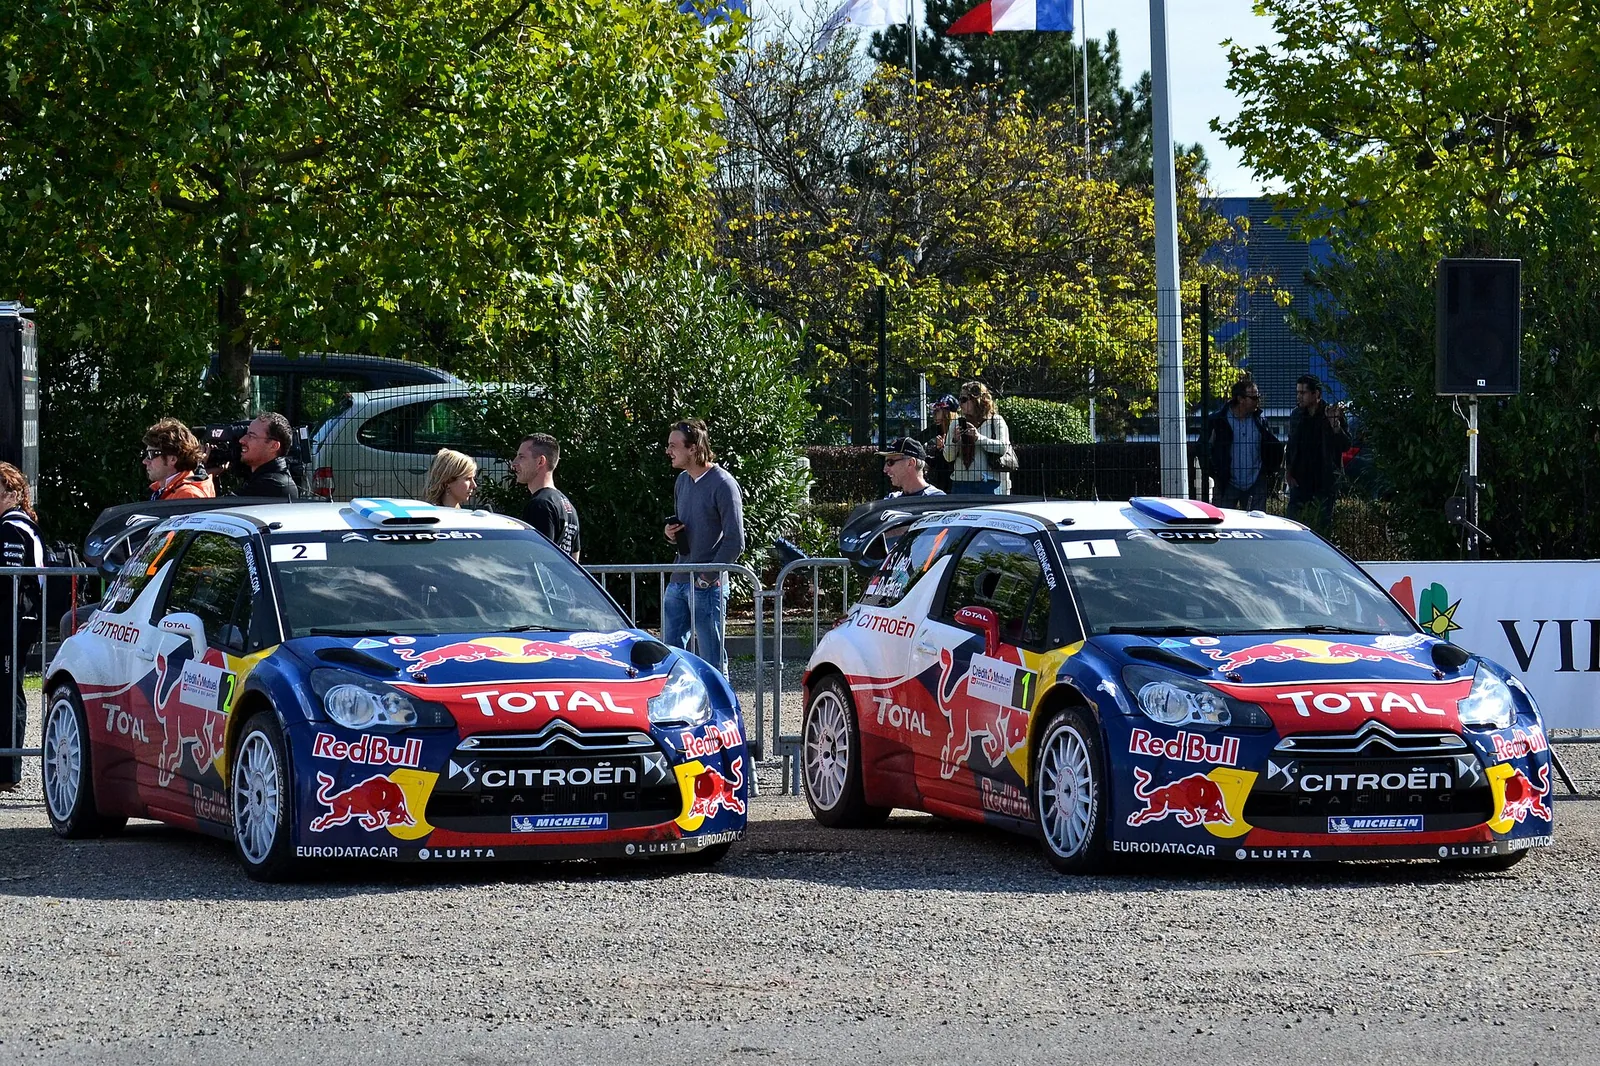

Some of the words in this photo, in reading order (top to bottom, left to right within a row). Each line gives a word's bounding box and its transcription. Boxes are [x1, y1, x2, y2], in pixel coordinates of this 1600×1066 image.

[372, 530, 483, 541] CITROËN
[1156, 530, 1264, 540] CITROËN
[292, 544, 308, 559] 2
[924, 528, 948, 572] 1
[1083, 541, 1096, 556] 1
[961, 609, 989, 622] TOTAL
[163, 620, 191, 630] TOTAL
[857, 614, 915, 639] CITROËN
[92, 621, 140, 645] CITROËN
[223, 675, 235, 712] 2
[1021, 672, 1031, 709] 1
[461, 690, 634, 717] TOTAL
[1276, 690, 1446, 717] TOTAL
[872, 696, 932, 736] TOTAL
[480, 761, 636, 787] CITROËN
[1299, 766, 1452, 792] CITROËN
[480, 791, 637, 803] RACING
[1298, 793, 1451, 805] RACING
[535, 816, 604, 828] MICHELIN
[1352, 817, 1418, 829] MICHELIN
[296, 846, 398, 858] EURODATACAR
[434, 849, 495, 858] LUHTA
[638, 842, 686, 853] LUHTA
[1112, 840, 1216, 856] EURODATACAR
[1251, 849, 1312, 859] LUHTA
[1451, 845, 1499, 856] LUHTA
